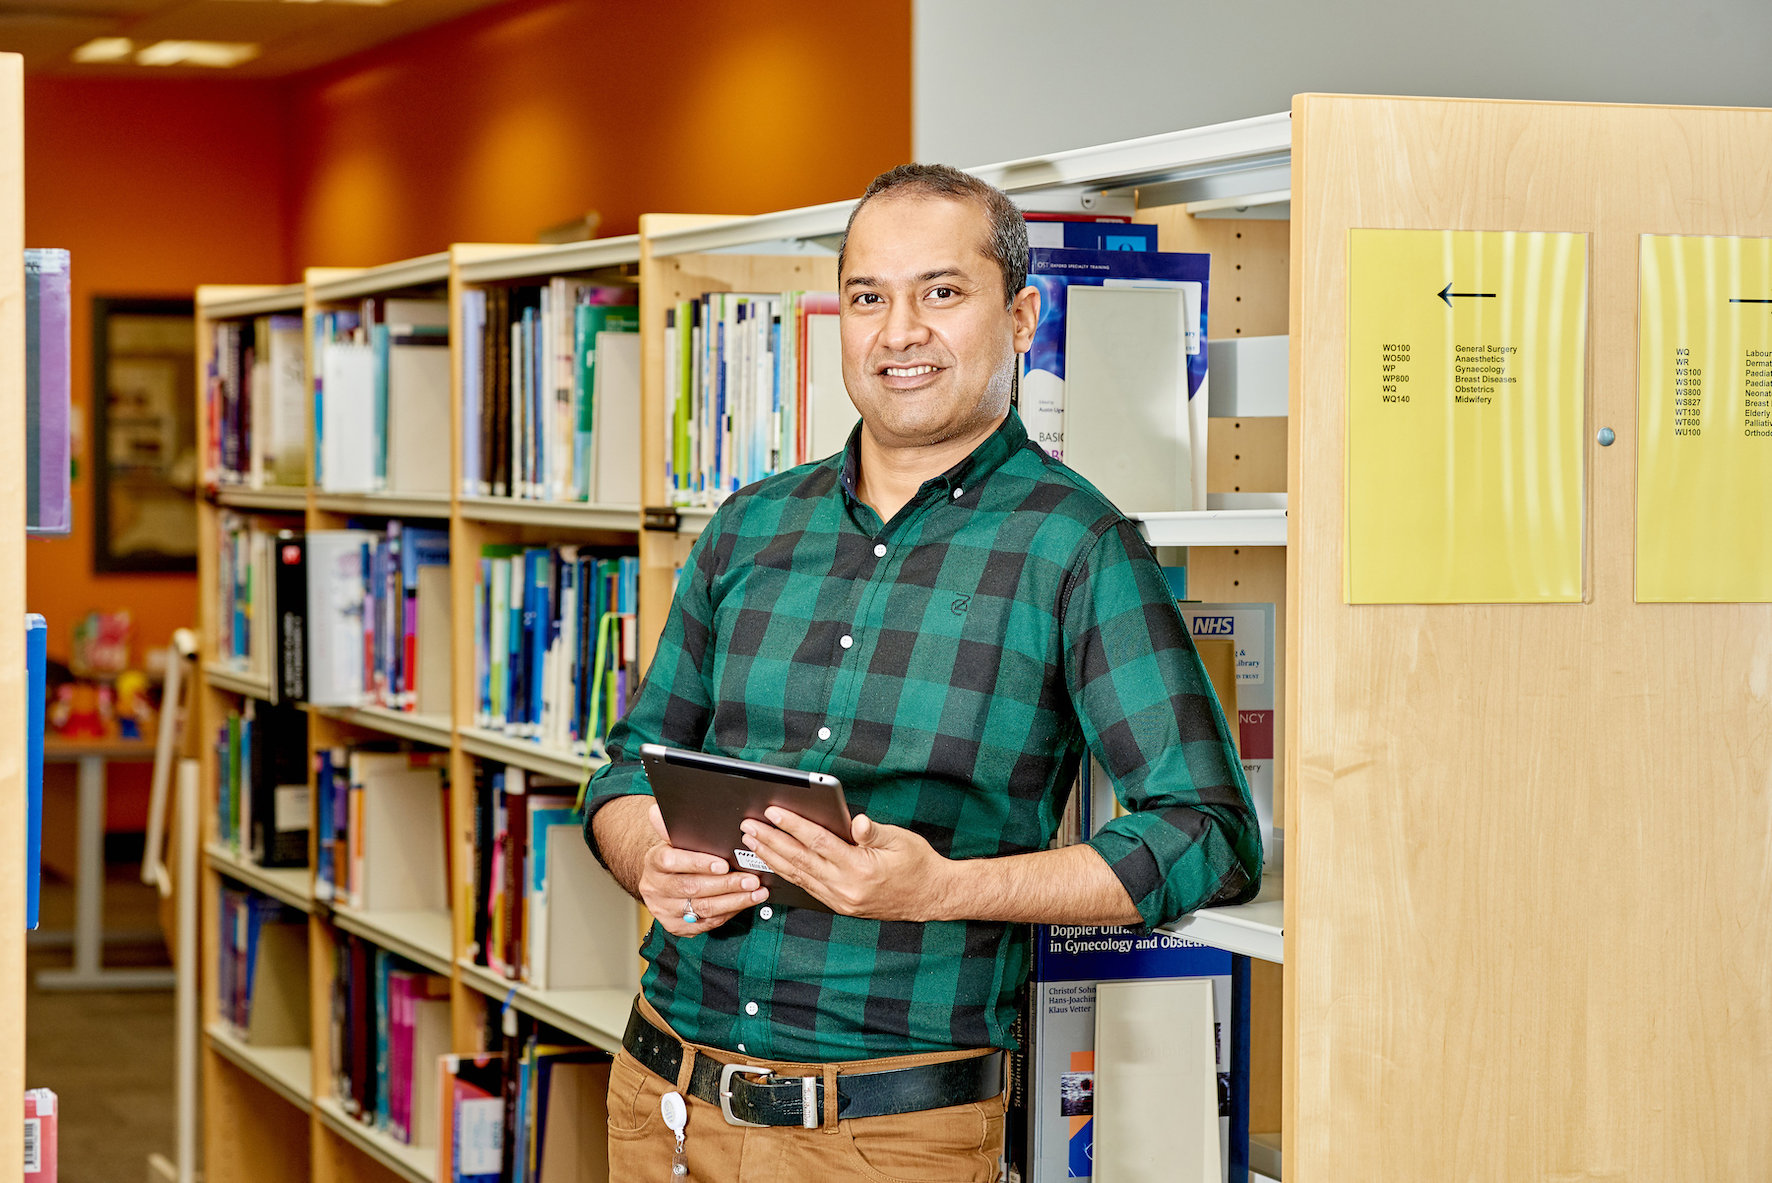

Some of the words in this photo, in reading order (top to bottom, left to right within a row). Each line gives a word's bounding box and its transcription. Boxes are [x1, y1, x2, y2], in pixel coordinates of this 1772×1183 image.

[1487, 345, 1517, 354] Surgery
[1455, 366, 1505, 374] Gynaecology
[1455, 396, 1492, 404] Midwifery
[1745, 410, 1770, 418] Elderly
[1194, 617, 1233, 634] NHS
[1240, 713, 1265, 724] NCY
[1051, 925, 1098, 938] Doppler
[1100, 926, 1132, 935] Ultra
[1050, 940, 1061, 952] in
[1065, 939, 1133, 954] Gynecology
[1136, 936, 1157, 949] and
[1049, 986, 1077, 995] Christof
[1014, 1054, 1024, 1108] Imaging
